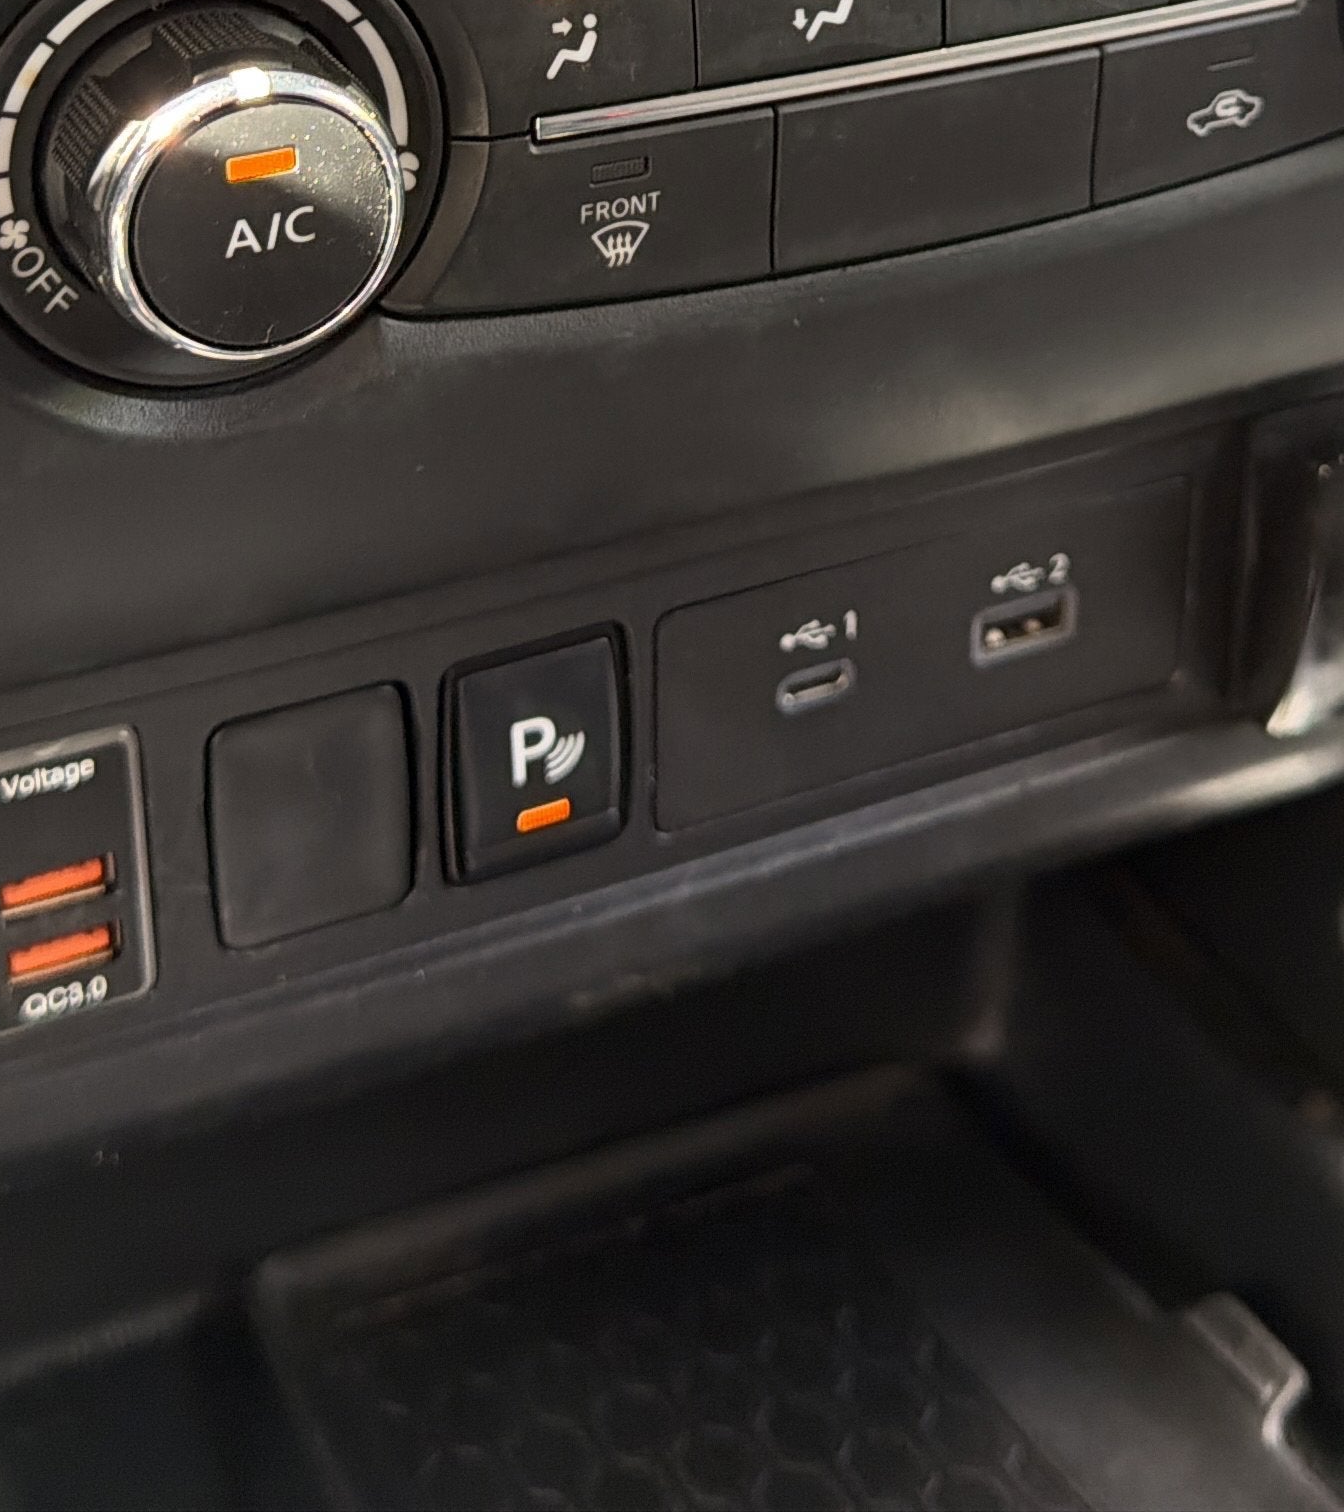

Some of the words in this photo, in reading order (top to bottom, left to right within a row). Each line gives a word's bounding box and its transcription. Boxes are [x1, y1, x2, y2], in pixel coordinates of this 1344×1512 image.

[224, 205, 317, 259] A/C
[580, 191, 661, 225] FRONT
[10, 247, 79, 314] OFF
[509, 717, 556, 787] P
